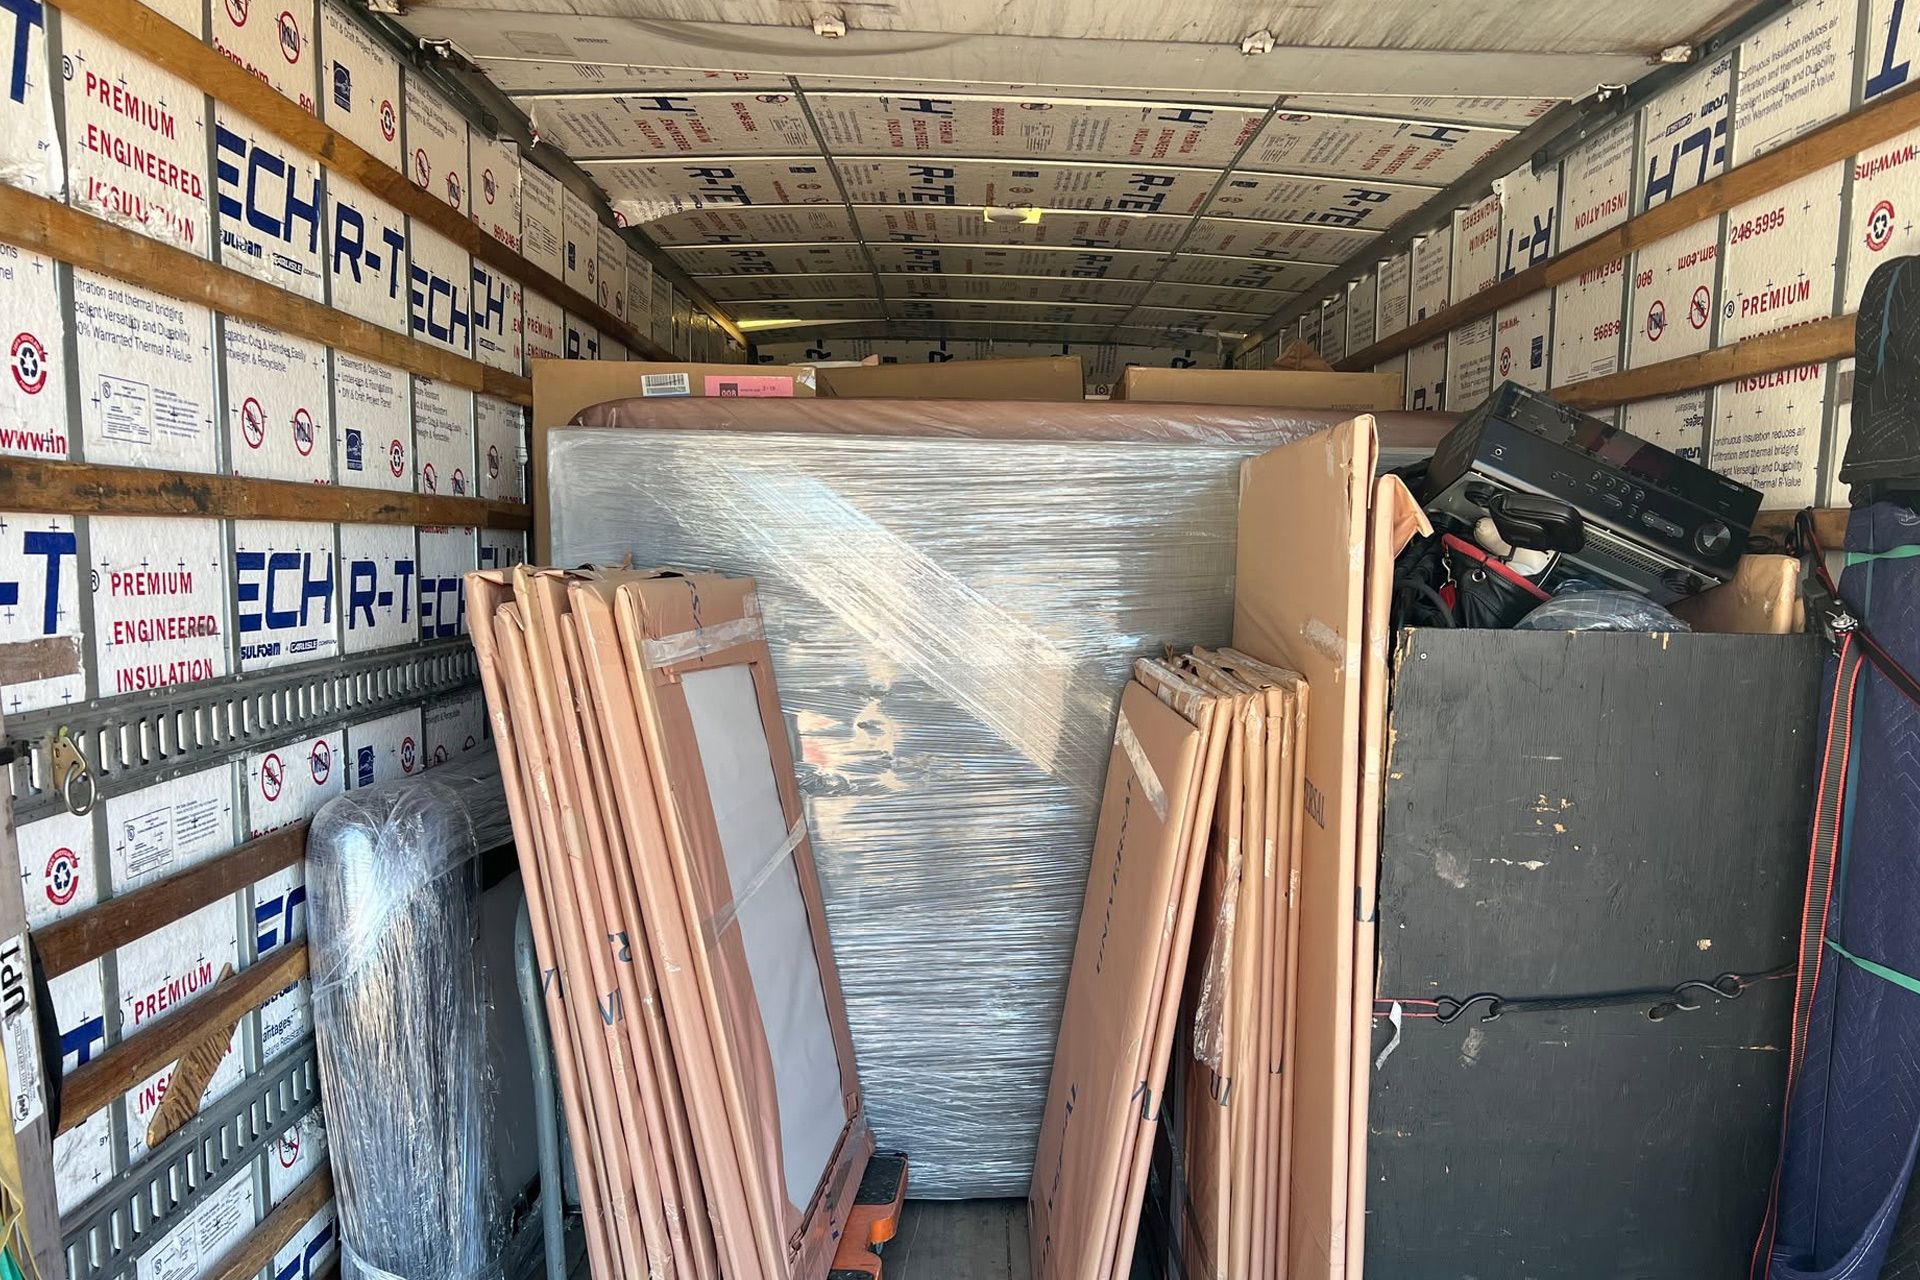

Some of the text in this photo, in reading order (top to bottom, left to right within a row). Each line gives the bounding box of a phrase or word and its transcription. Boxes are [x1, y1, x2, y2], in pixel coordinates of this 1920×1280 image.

[1792, 69, 1804, 86] and
[86, 71, 175, 140] PREMIUM
[88, 124, 202, 199] ENGINEERED
[1575, 190, 1627, 229] INSULATION
[108, 289, 123, 304] and
[125, 293, 154, 314] thermal
[1741, 280, 1810, 318] PREMIUM
[142, 320, 156, 334] and
[134, 336, 164, 357] Thermal
[111, 572, 193, 597] PREMIUM
[114, 615, 216, 645] ENGINEERED
[117, 658, 214, 693] INSULATION
[135, 963, 213, 1025] PREMIUM
